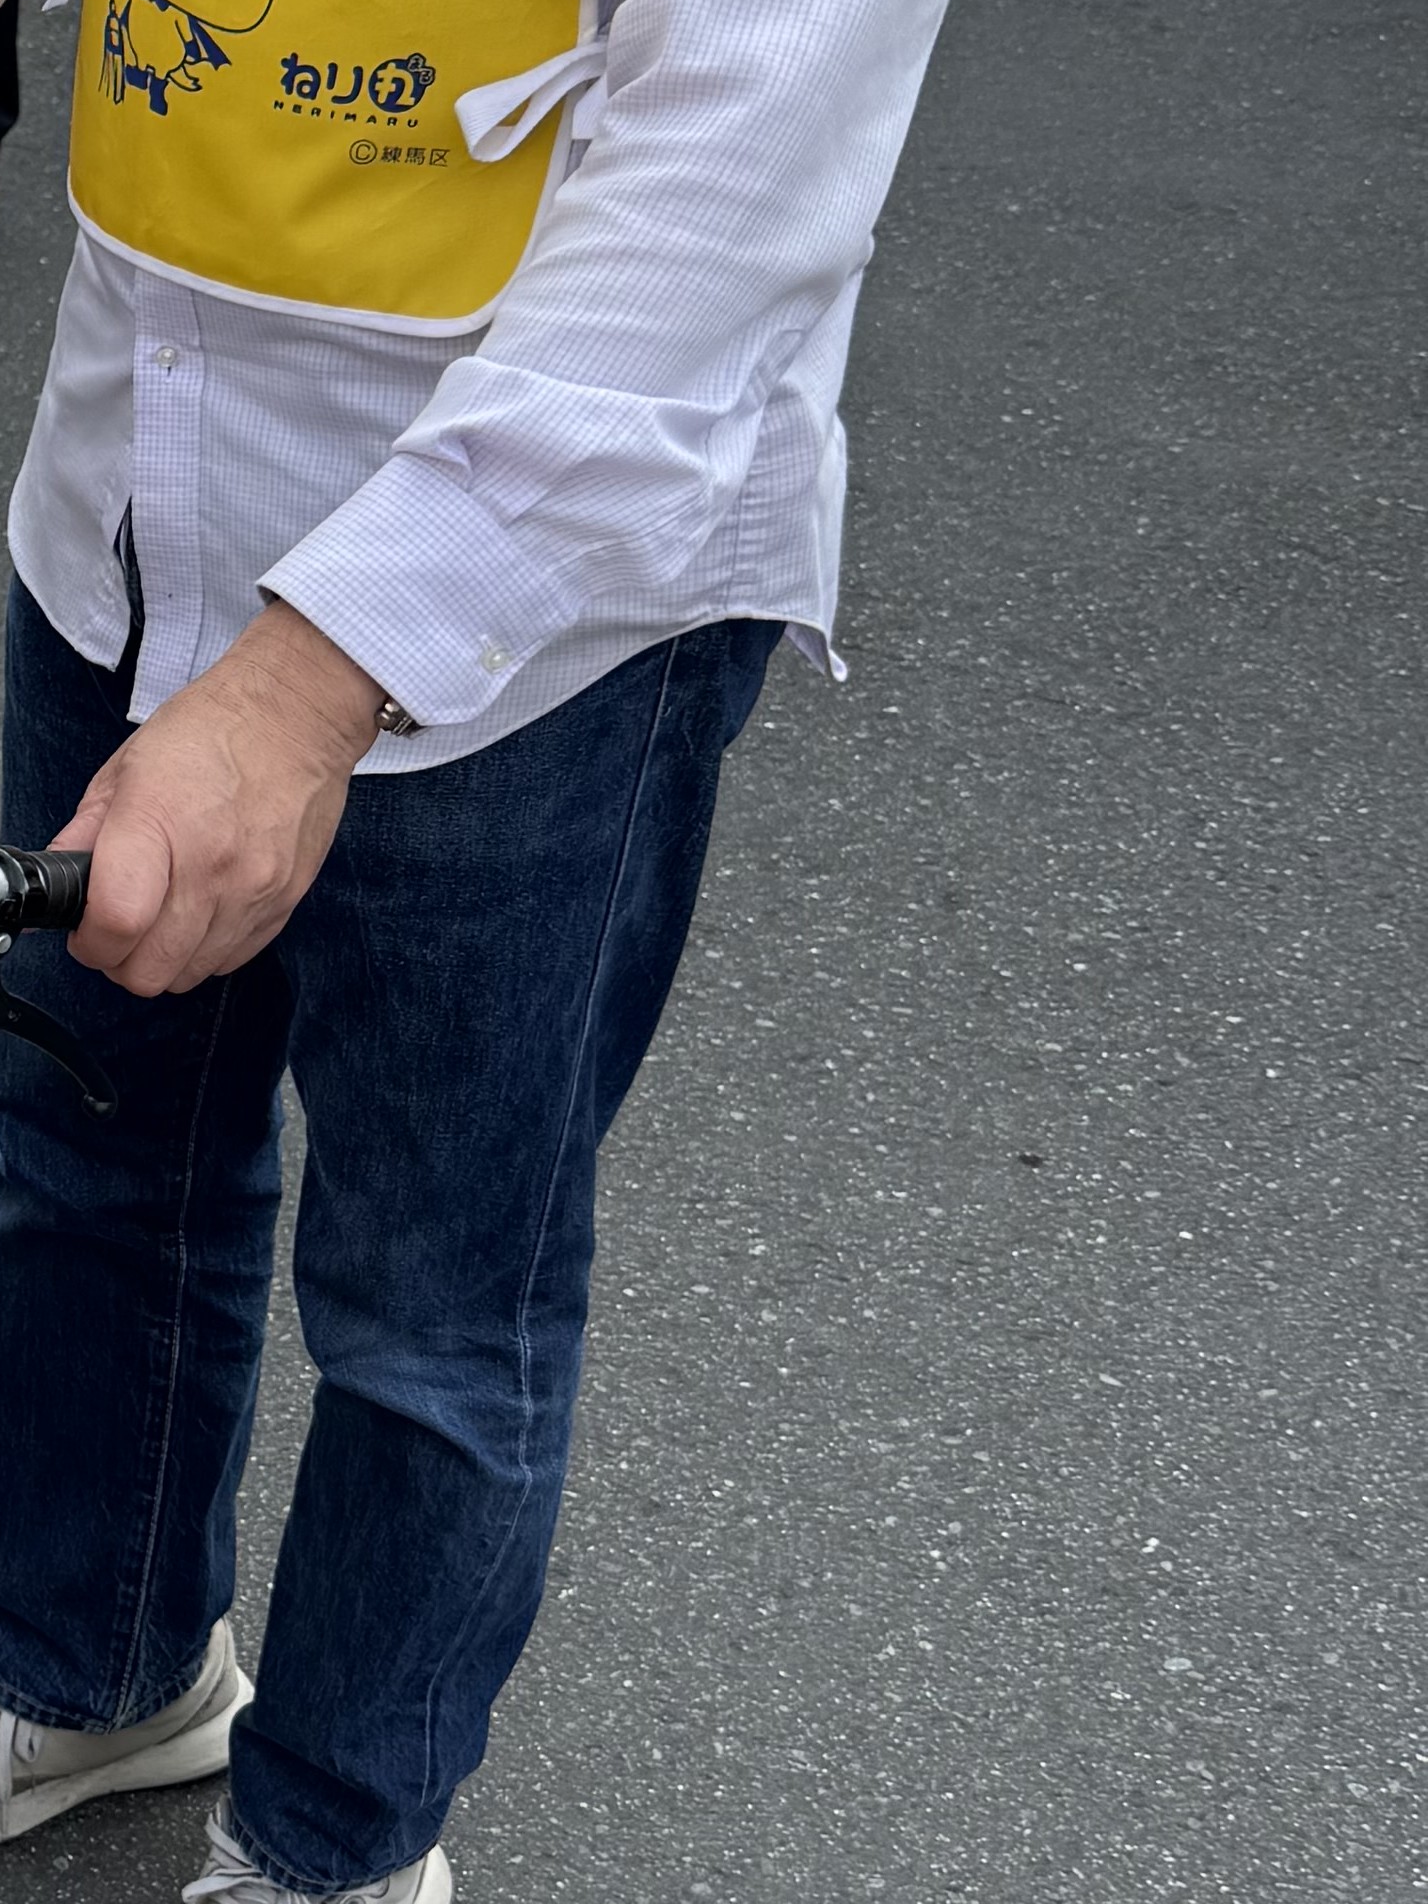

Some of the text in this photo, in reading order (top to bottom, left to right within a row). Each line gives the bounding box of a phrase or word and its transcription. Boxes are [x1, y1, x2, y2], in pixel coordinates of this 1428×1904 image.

[280, 52, 426, 114] ねり丸
[272, 99, 419, 129] NERIMARU
